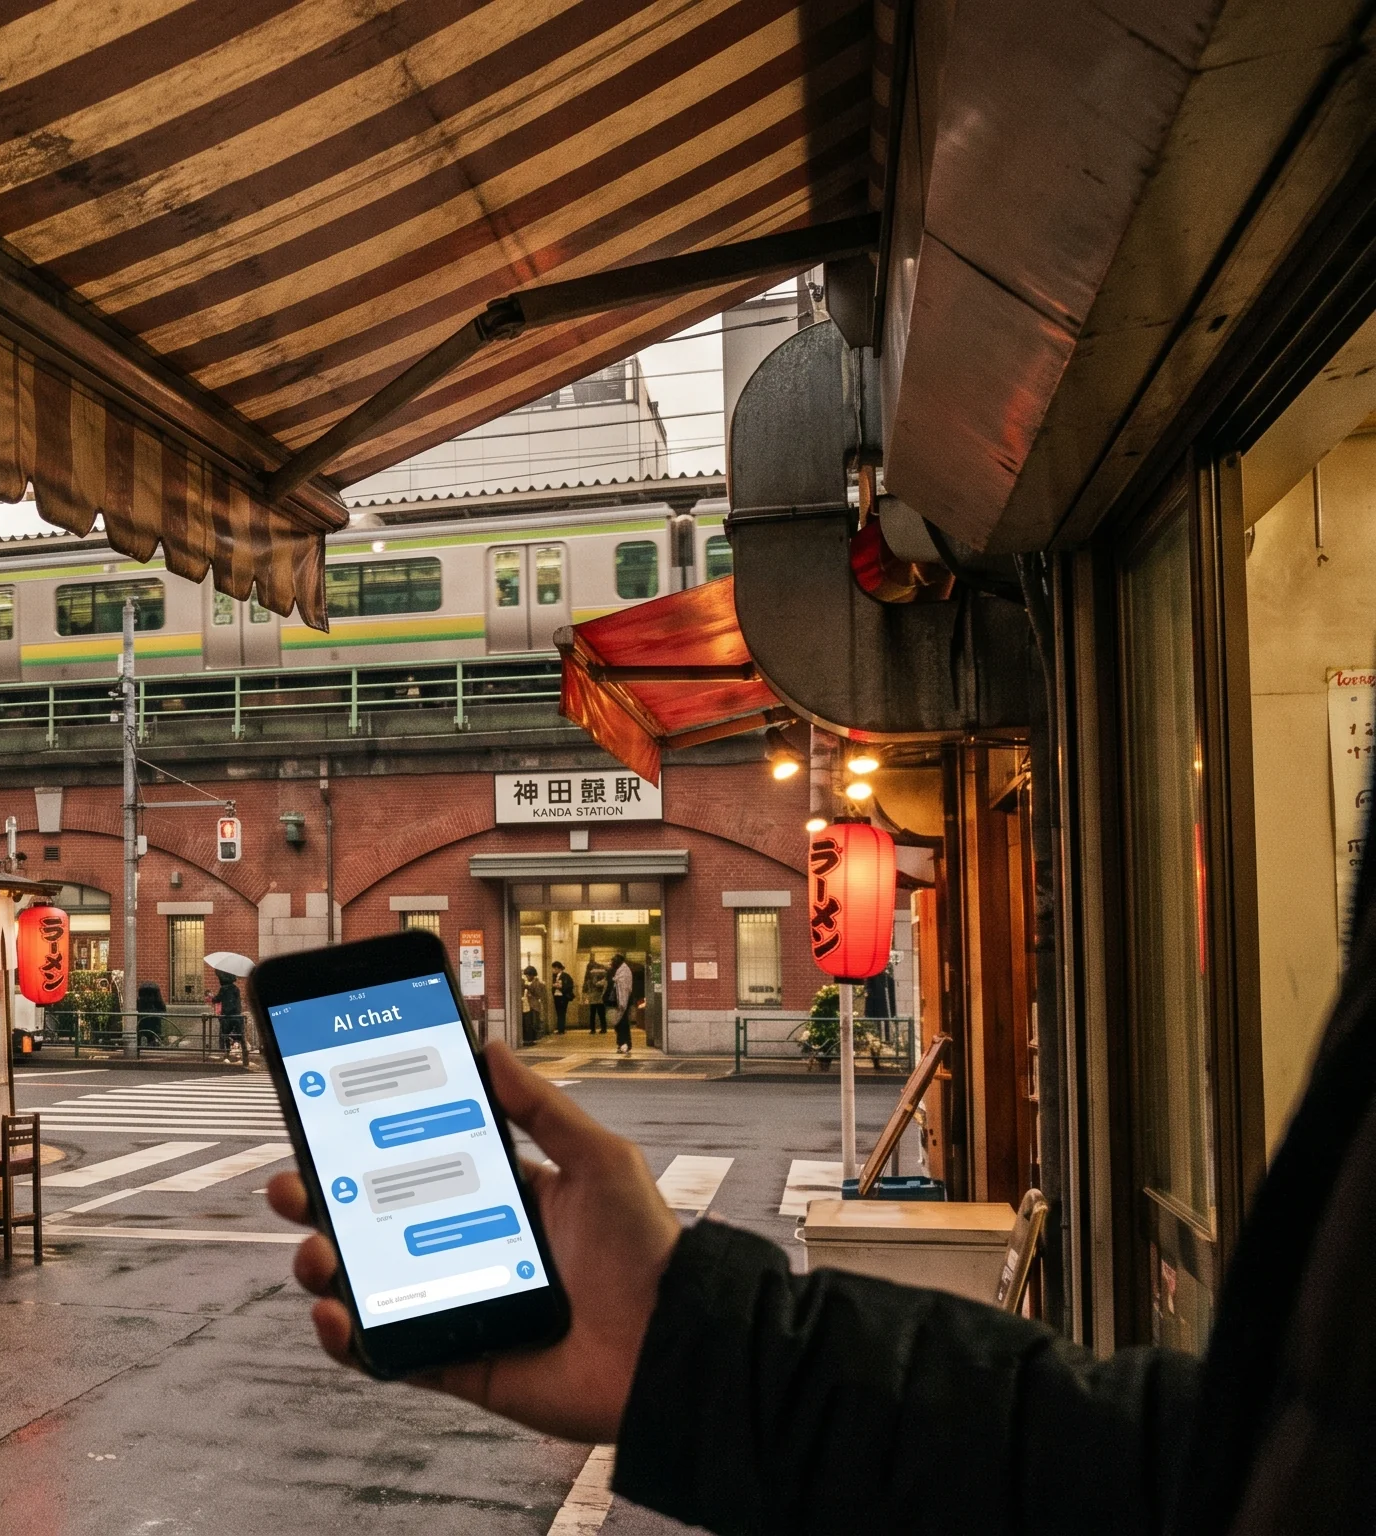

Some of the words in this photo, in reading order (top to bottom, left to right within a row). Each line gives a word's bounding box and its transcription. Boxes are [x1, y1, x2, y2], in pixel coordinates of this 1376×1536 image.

[532, 807, 572, 817] KANDA
[576, 806, 623, 816] STATION
[810, 838, 842, 960] ラーメン
[41, 917, 64, 992] ラーメン
[334, 1015, 353, 1033] AI
[358, 1005, 402, 1028] chat
